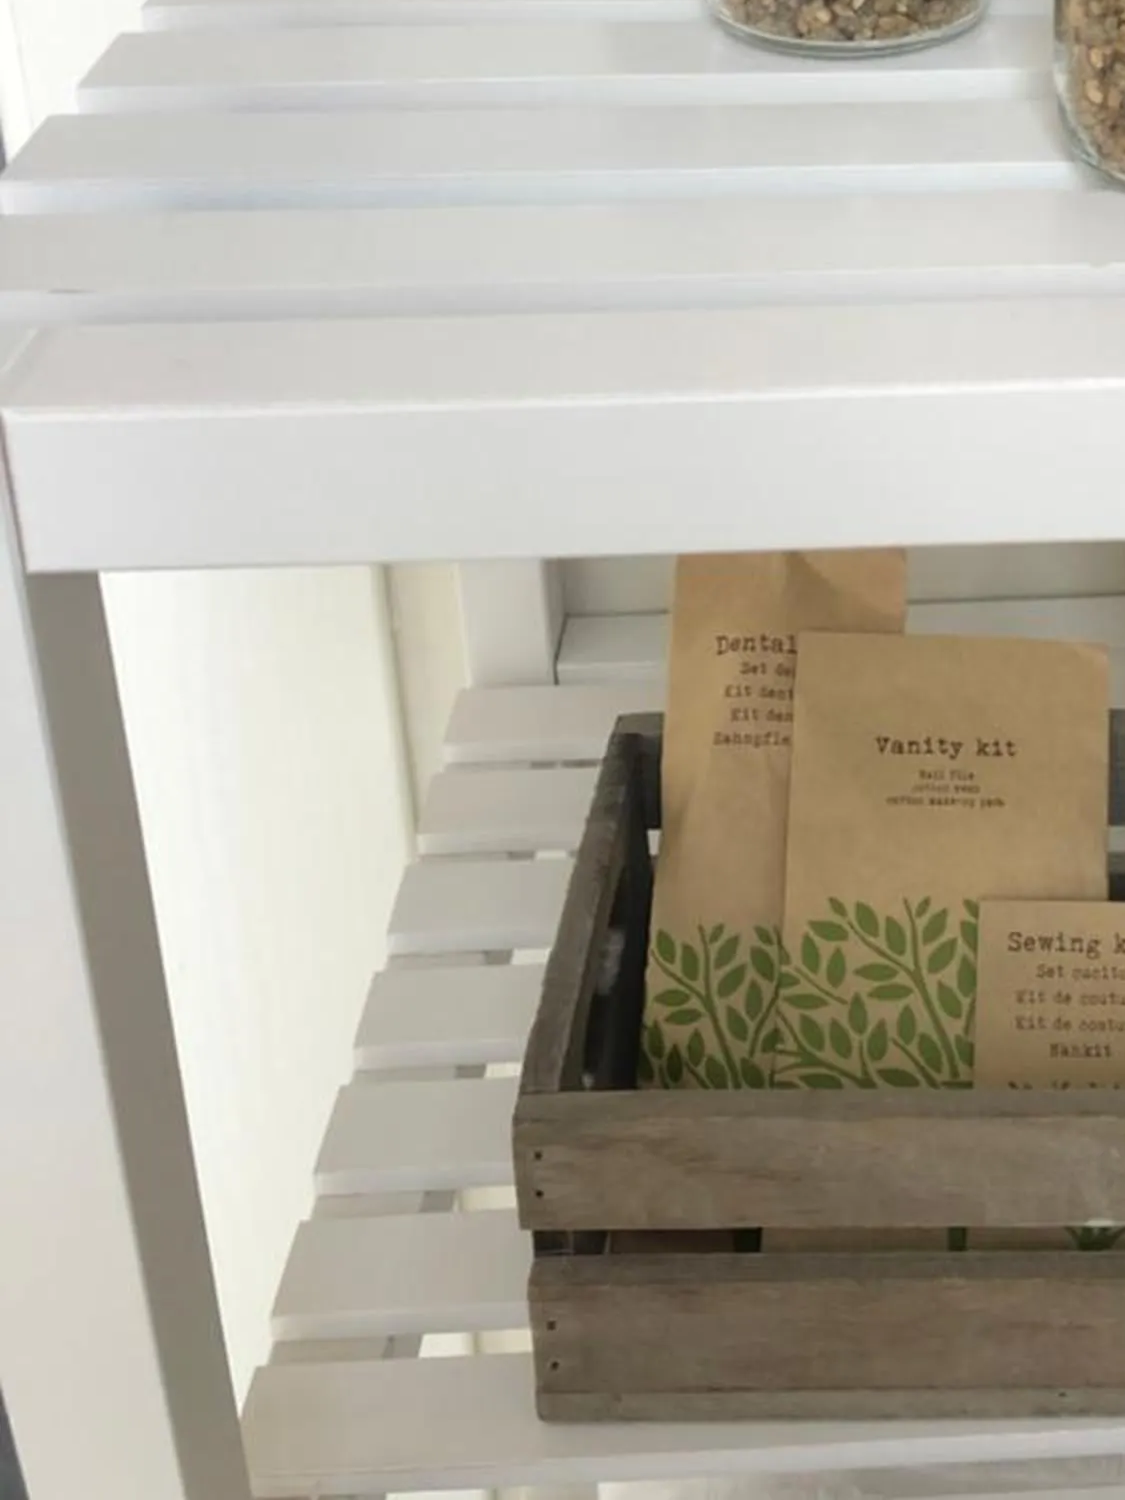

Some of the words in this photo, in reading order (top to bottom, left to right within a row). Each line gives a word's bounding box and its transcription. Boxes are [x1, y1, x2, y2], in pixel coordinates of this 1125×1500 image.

[715, 633, 798, 656] Dental
[875, 735, 965, 760] Vanity
[975, 737, 1018, 758] kit
[1006, 931, 1103, 959] Sewing
[1035, 963, 1064, 979] Set
[1014, 990, 1046, 1005] Kit
[1053, 989, 1073, 1005] de
[1014, 1015, 1046, 1031] Kit
[1053, 1015, 1073, 1031] de
